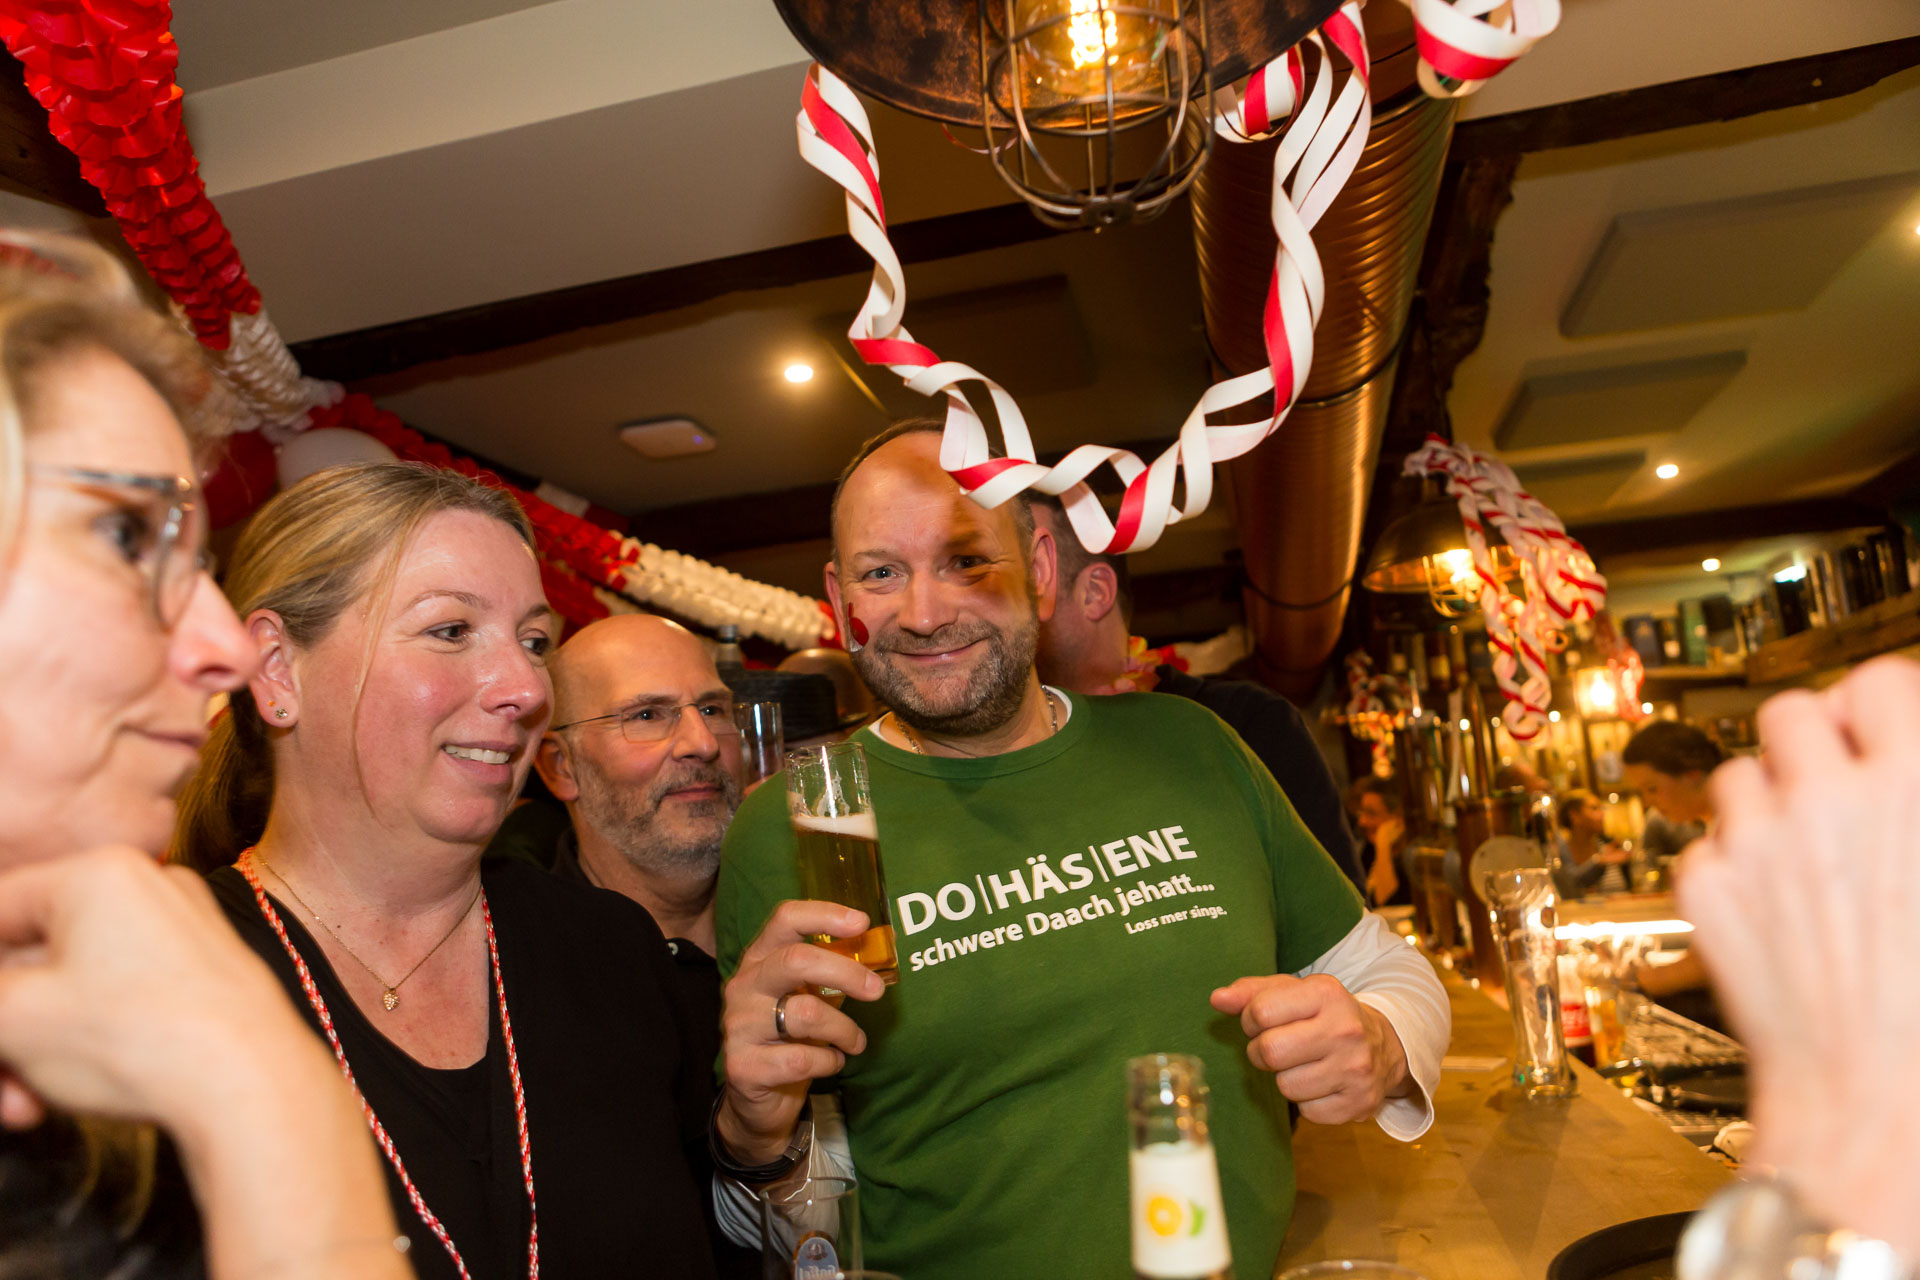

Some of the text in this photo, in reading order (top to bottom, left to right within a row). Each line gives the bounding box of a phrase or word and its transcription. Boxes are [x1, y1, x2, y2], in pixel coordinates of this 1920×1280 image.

[909, 873, 1215, 972] schwere Daach jehatt...
[1124, 903, 1228, 935] Loss mer singe.
